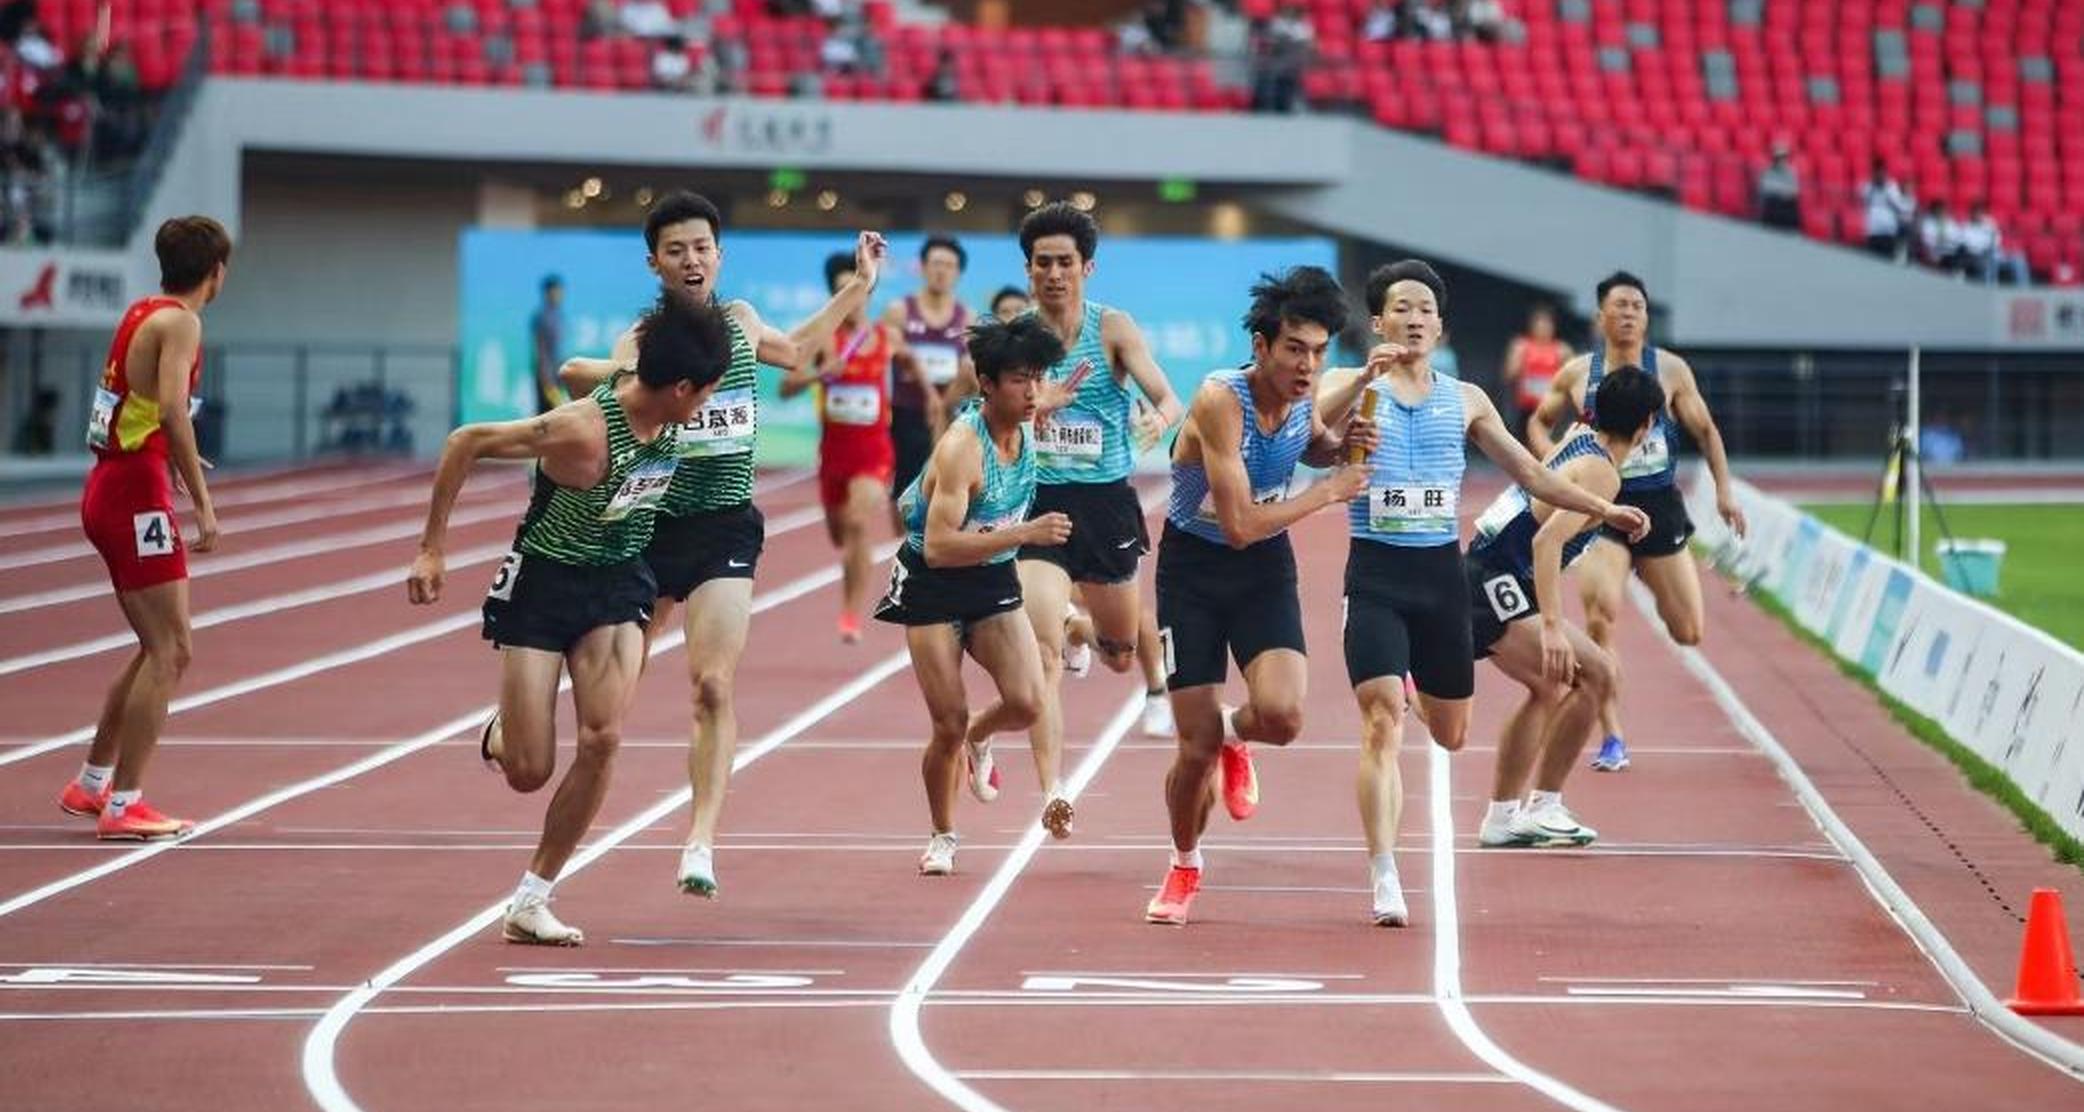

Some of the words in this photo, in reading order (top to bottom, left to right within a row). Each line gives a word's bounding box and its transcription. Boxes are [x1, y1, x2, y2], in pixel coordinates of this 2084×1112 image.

[143, 516, 167, 549] 4
[1493, 580, 1520, 613] 6
[1021, 976, 1325, 992] 2
